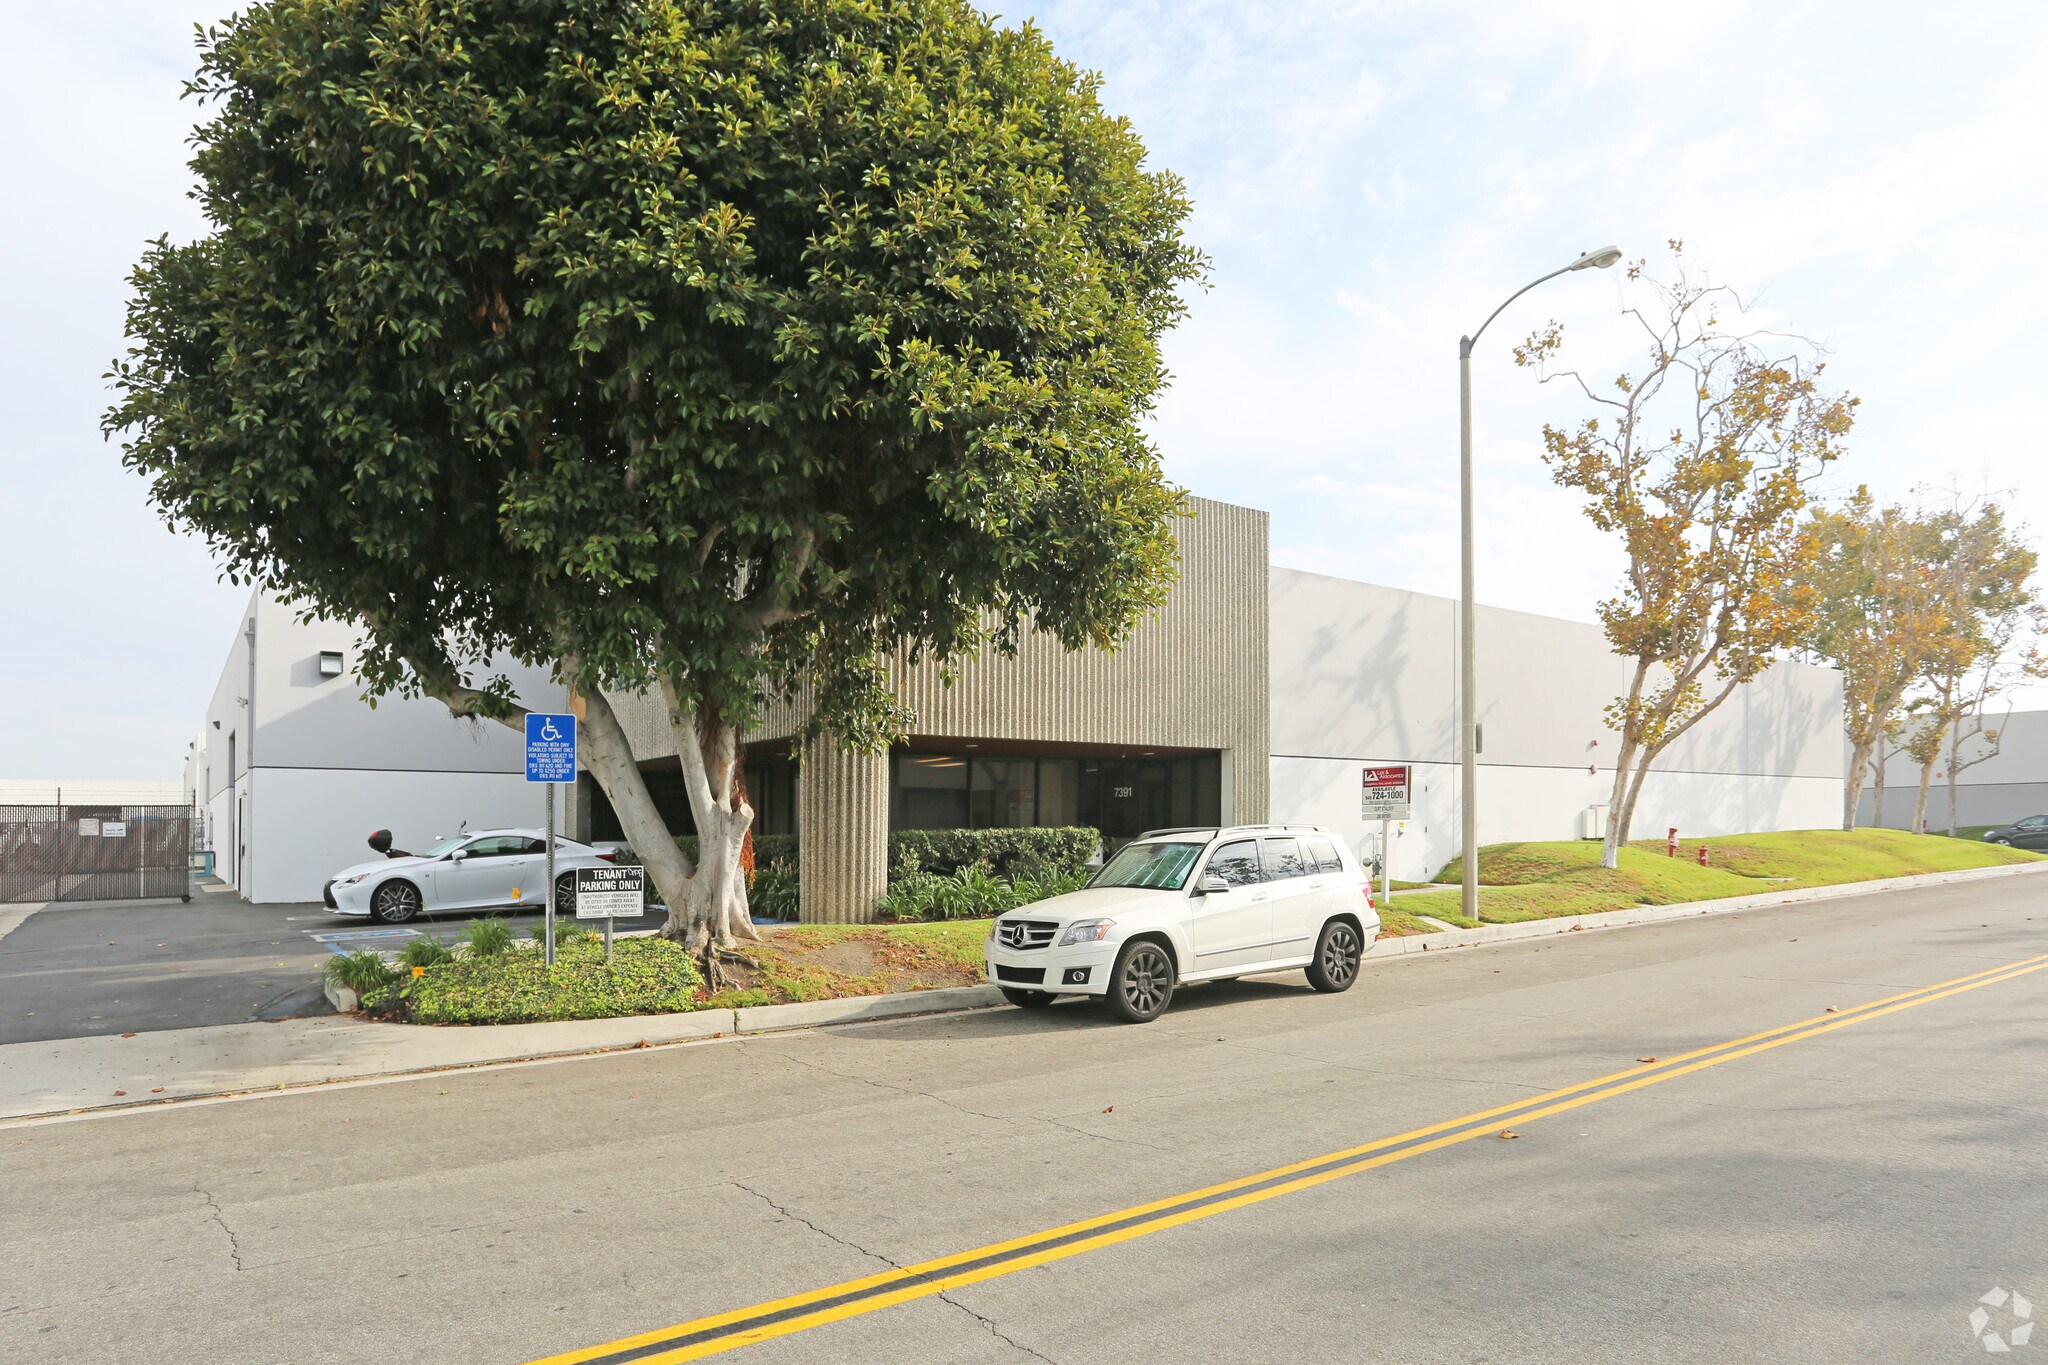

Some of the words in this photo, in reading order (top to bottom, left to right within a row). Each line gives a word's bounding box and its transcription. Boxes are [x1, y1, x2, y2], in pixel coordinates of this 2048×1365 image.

[1114, 787, 1132, 798] 7391
[1372, 790, 1404, 800] 724-1000
[593, 870, 627, 880] TENANT
[580, 880, 616, 891] PARKING
[618, 880, 640, 890] ONLY
